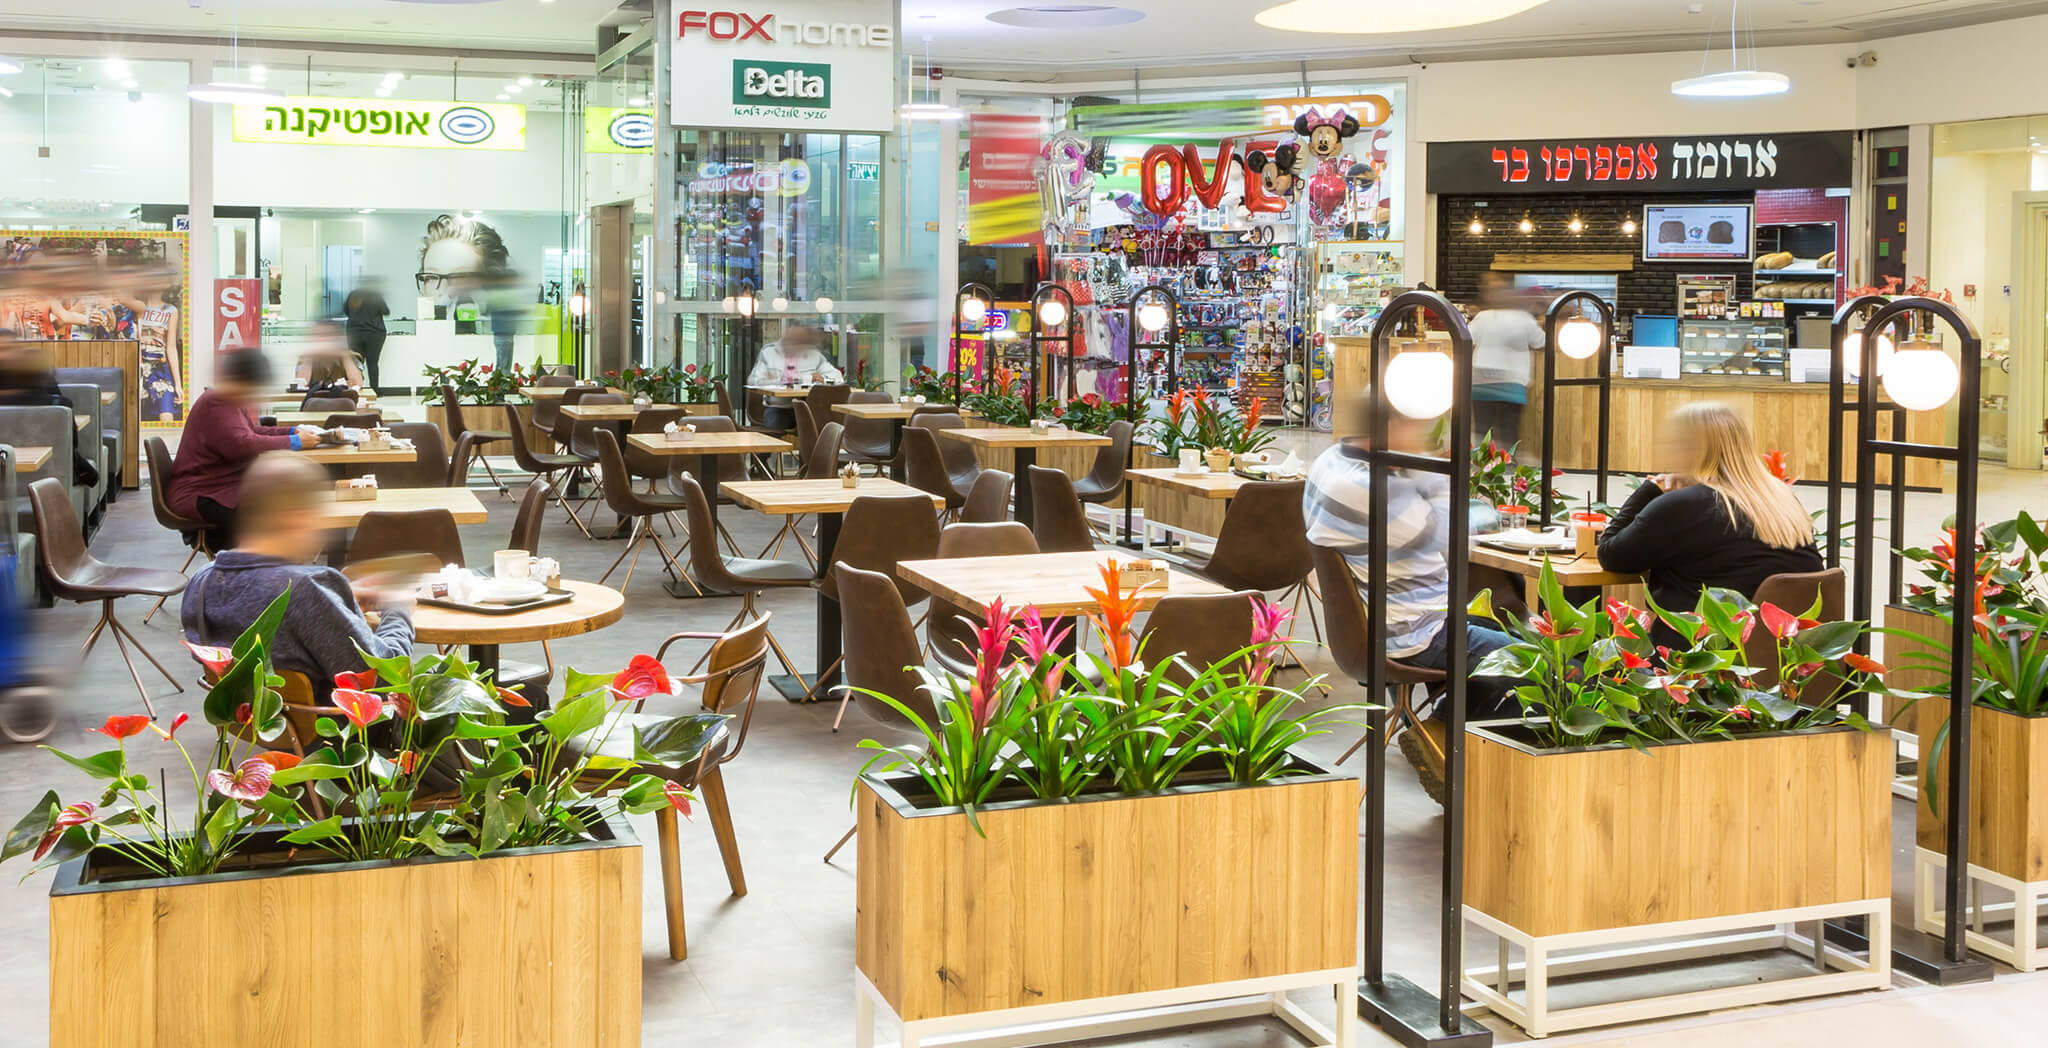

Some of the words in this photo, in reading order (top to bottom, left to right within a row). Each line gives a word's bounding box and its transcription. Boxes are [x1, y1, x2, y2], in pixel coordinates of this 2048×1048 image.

[679, 11, 775, 42] FOX
[743, 67, 824, 98] Delta
[265, 106, 430, 138] אופטיקנה
[851, 164, 878, 179] יציאה
[1491, 145, 1530, 183] בר
[1541, 142, 1658, 182] אספרסו
[1672, 139, 1778, 180] ארומה
